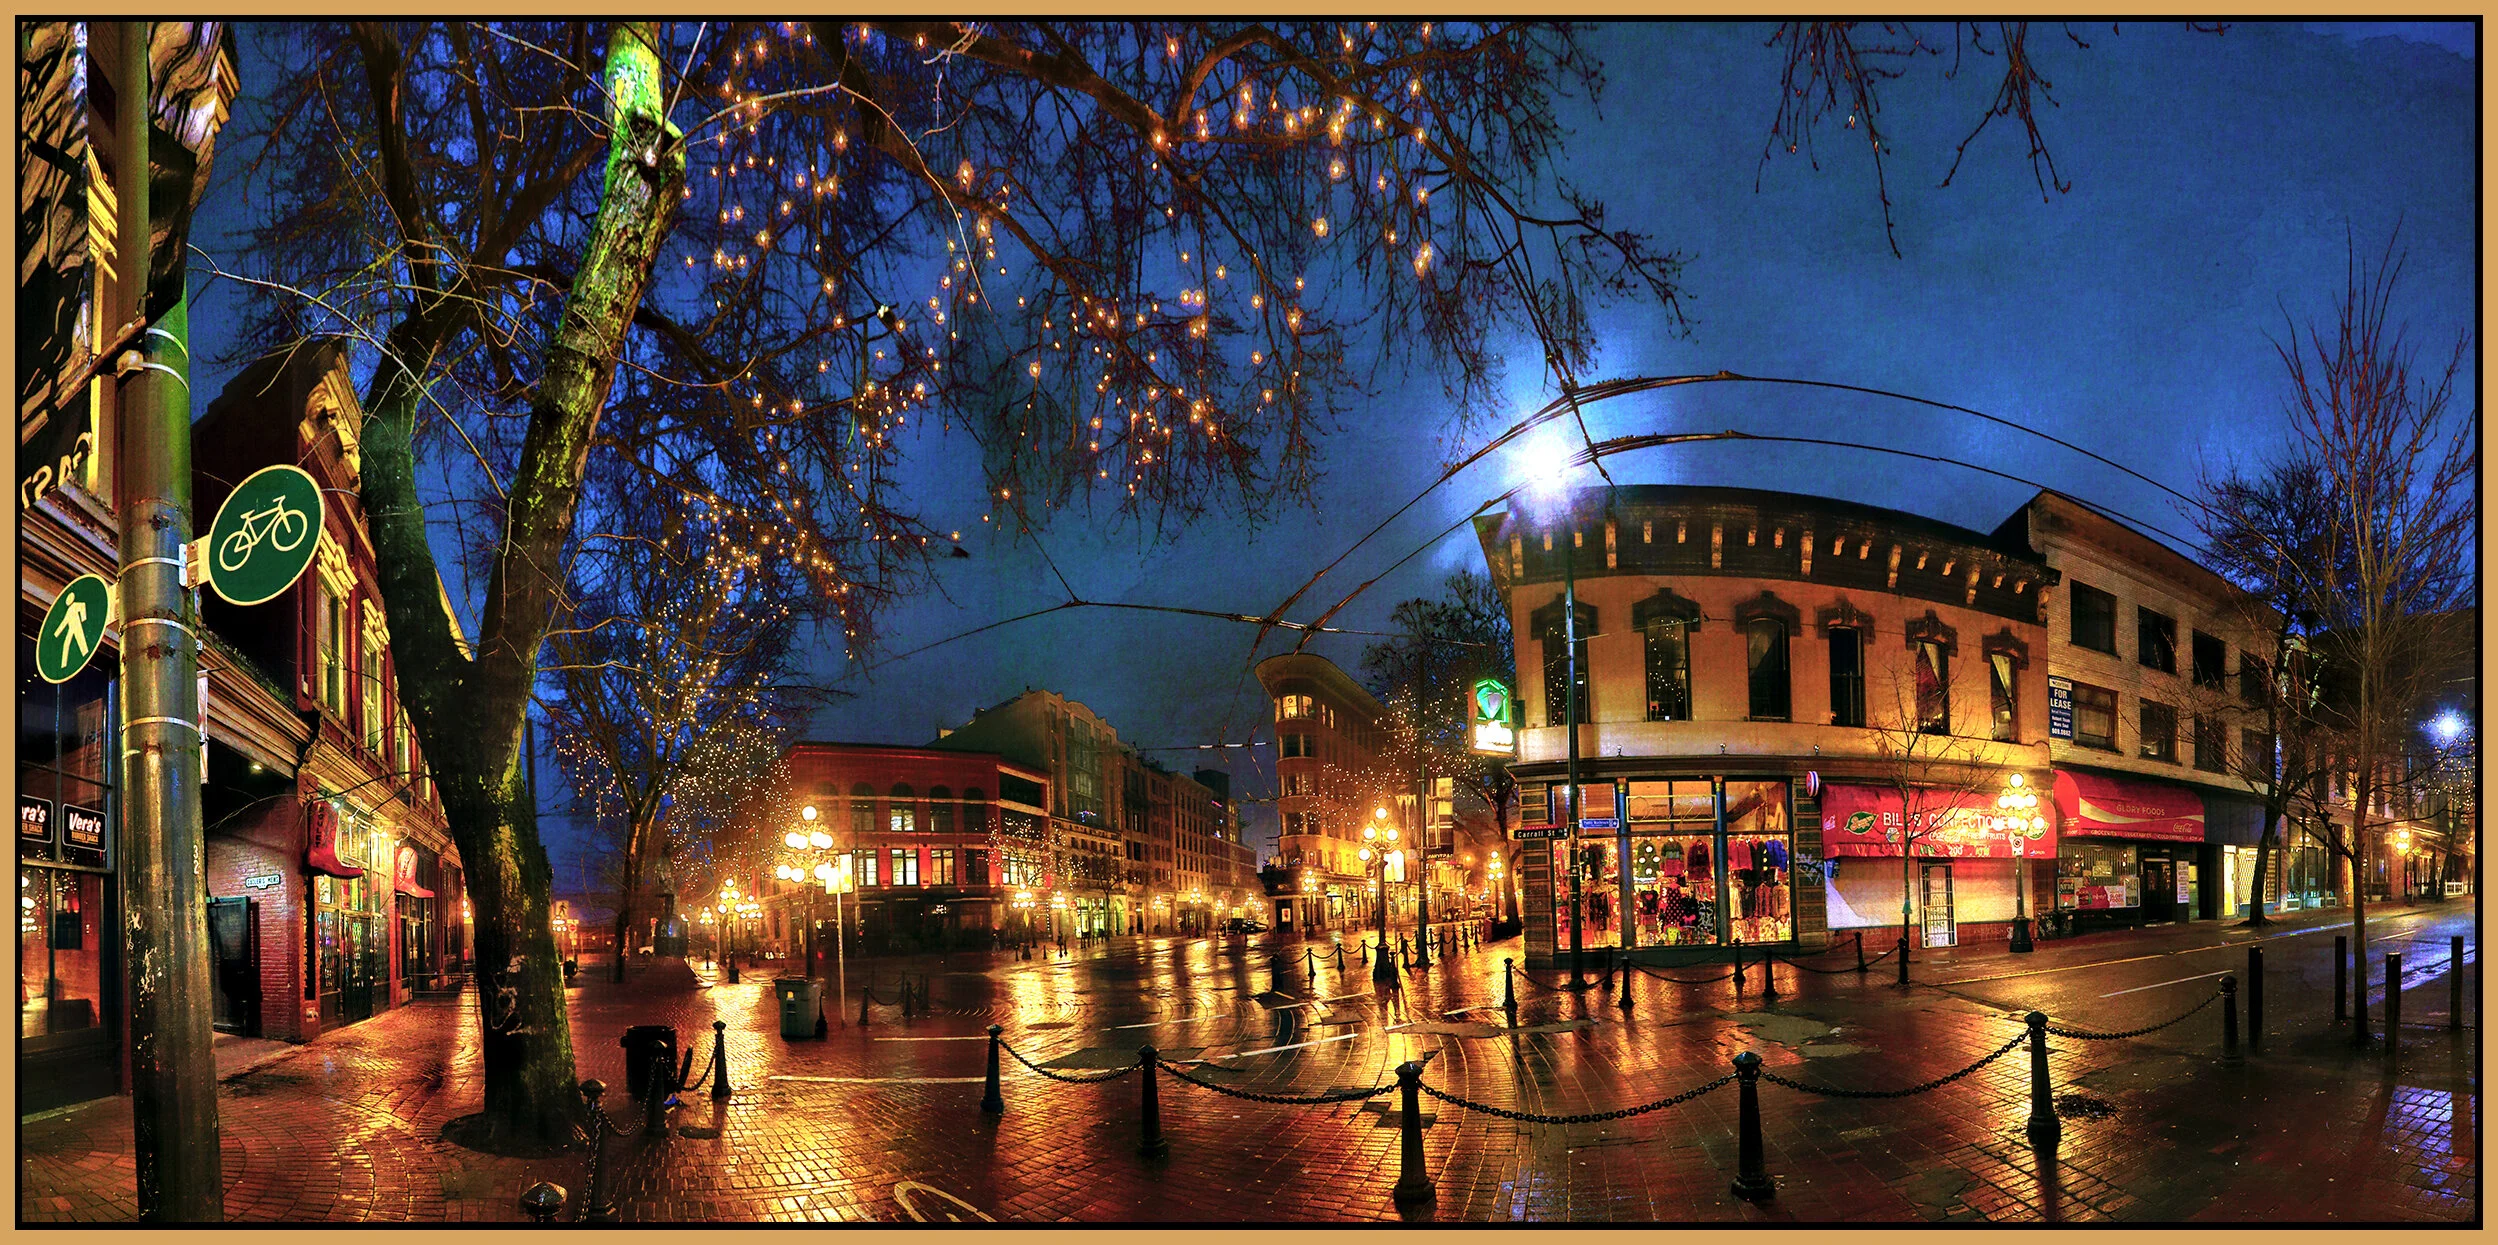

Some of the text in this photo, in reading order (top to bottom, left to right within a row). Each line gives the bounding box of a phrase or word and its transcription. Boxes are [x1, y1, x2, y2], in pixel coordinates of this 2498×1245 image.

[2054, 689, 2067, 699] FOR
[2050, 698, 2071, 710] LEASE
[2117, 804, 2165, 816] GLORY FOODS
[69, 813, 101, 833] Vera's
[1883, 812, 1922, 826] BIL'S
[1517, 830, 1544, 838] Carrall
[1547, 829, 1555, 837] St
[1988, 832, 2006, 840] FRUITS
